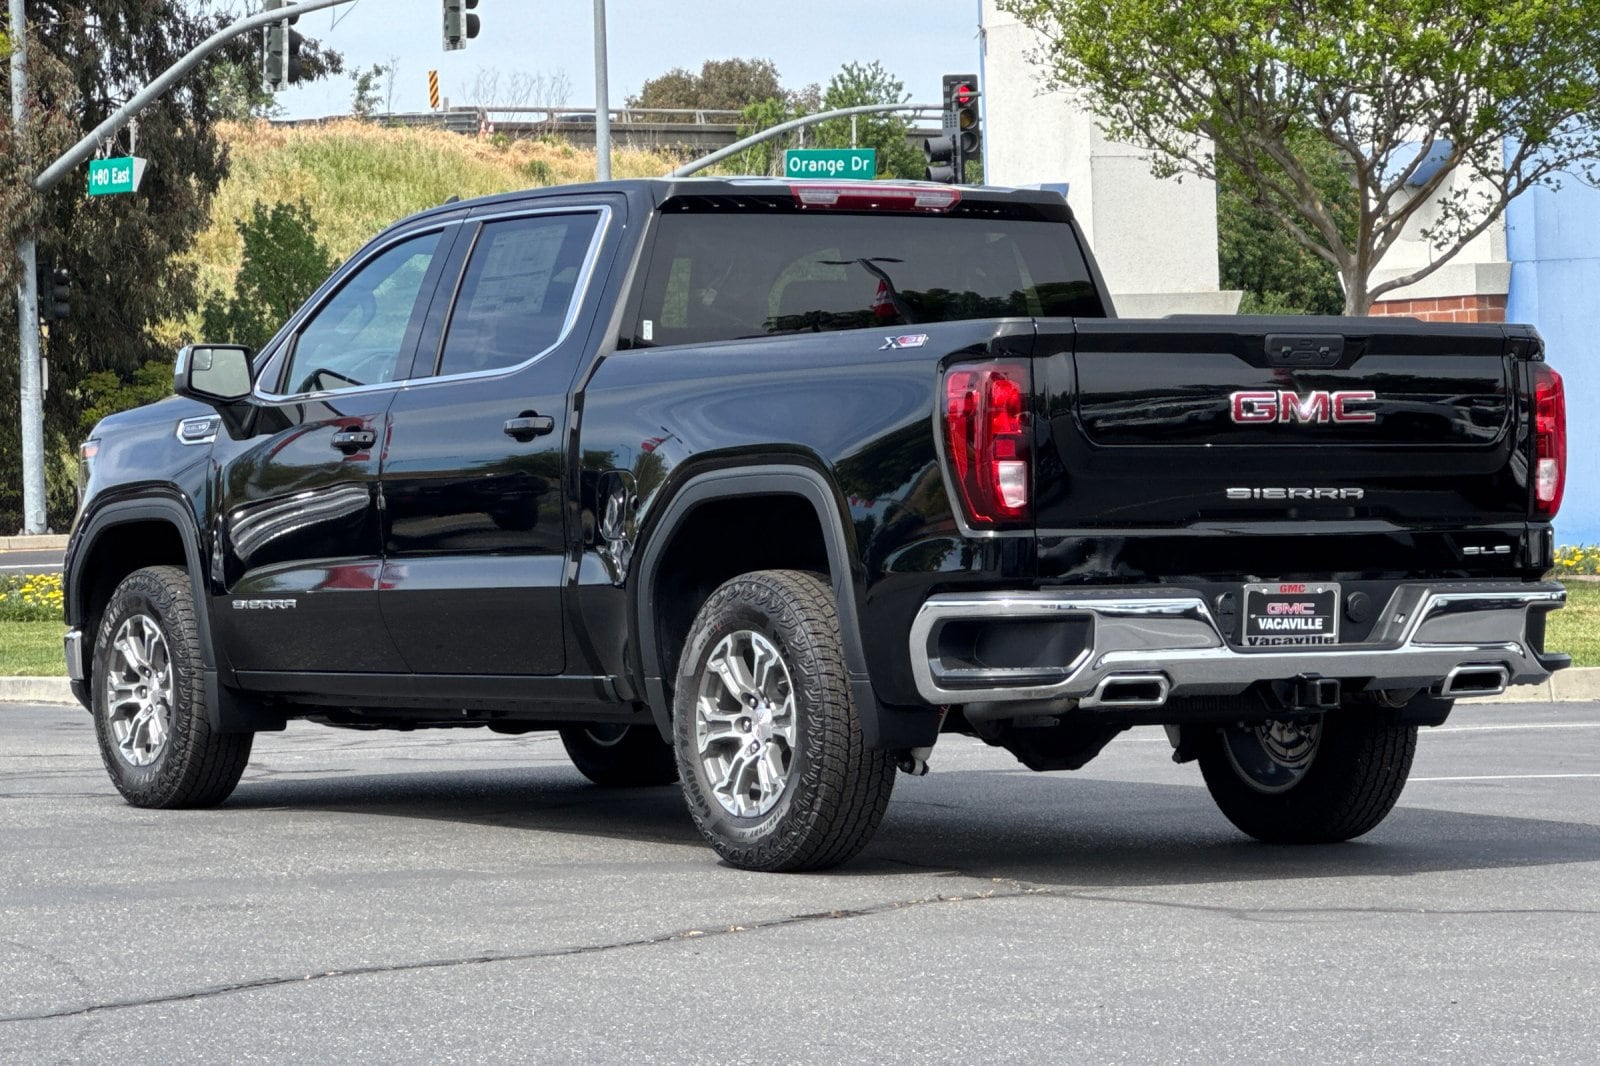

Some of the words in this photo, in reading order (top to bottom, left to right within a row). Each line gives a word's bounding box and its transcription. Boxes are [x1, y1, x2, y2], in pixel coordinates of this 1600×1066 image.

[789, 157, 845, 176] Orange
[851, 156, 869, 171] Dr
[92, 168, 109, 186] I-80
[112, 167, 130, 184] East
[1229, 390, 1376, 423] GMC
[1226, 488, 1364, 499] SIERRA
[1279, 584, 1306, 593] GMC
[232, 599, 297, 610] SIERRA
[1267, 602, 1315, 615] GMC
[1258, 618, 1323, 630] VACAVILLE
[1247, 635, 1336, 646] Vacaville
